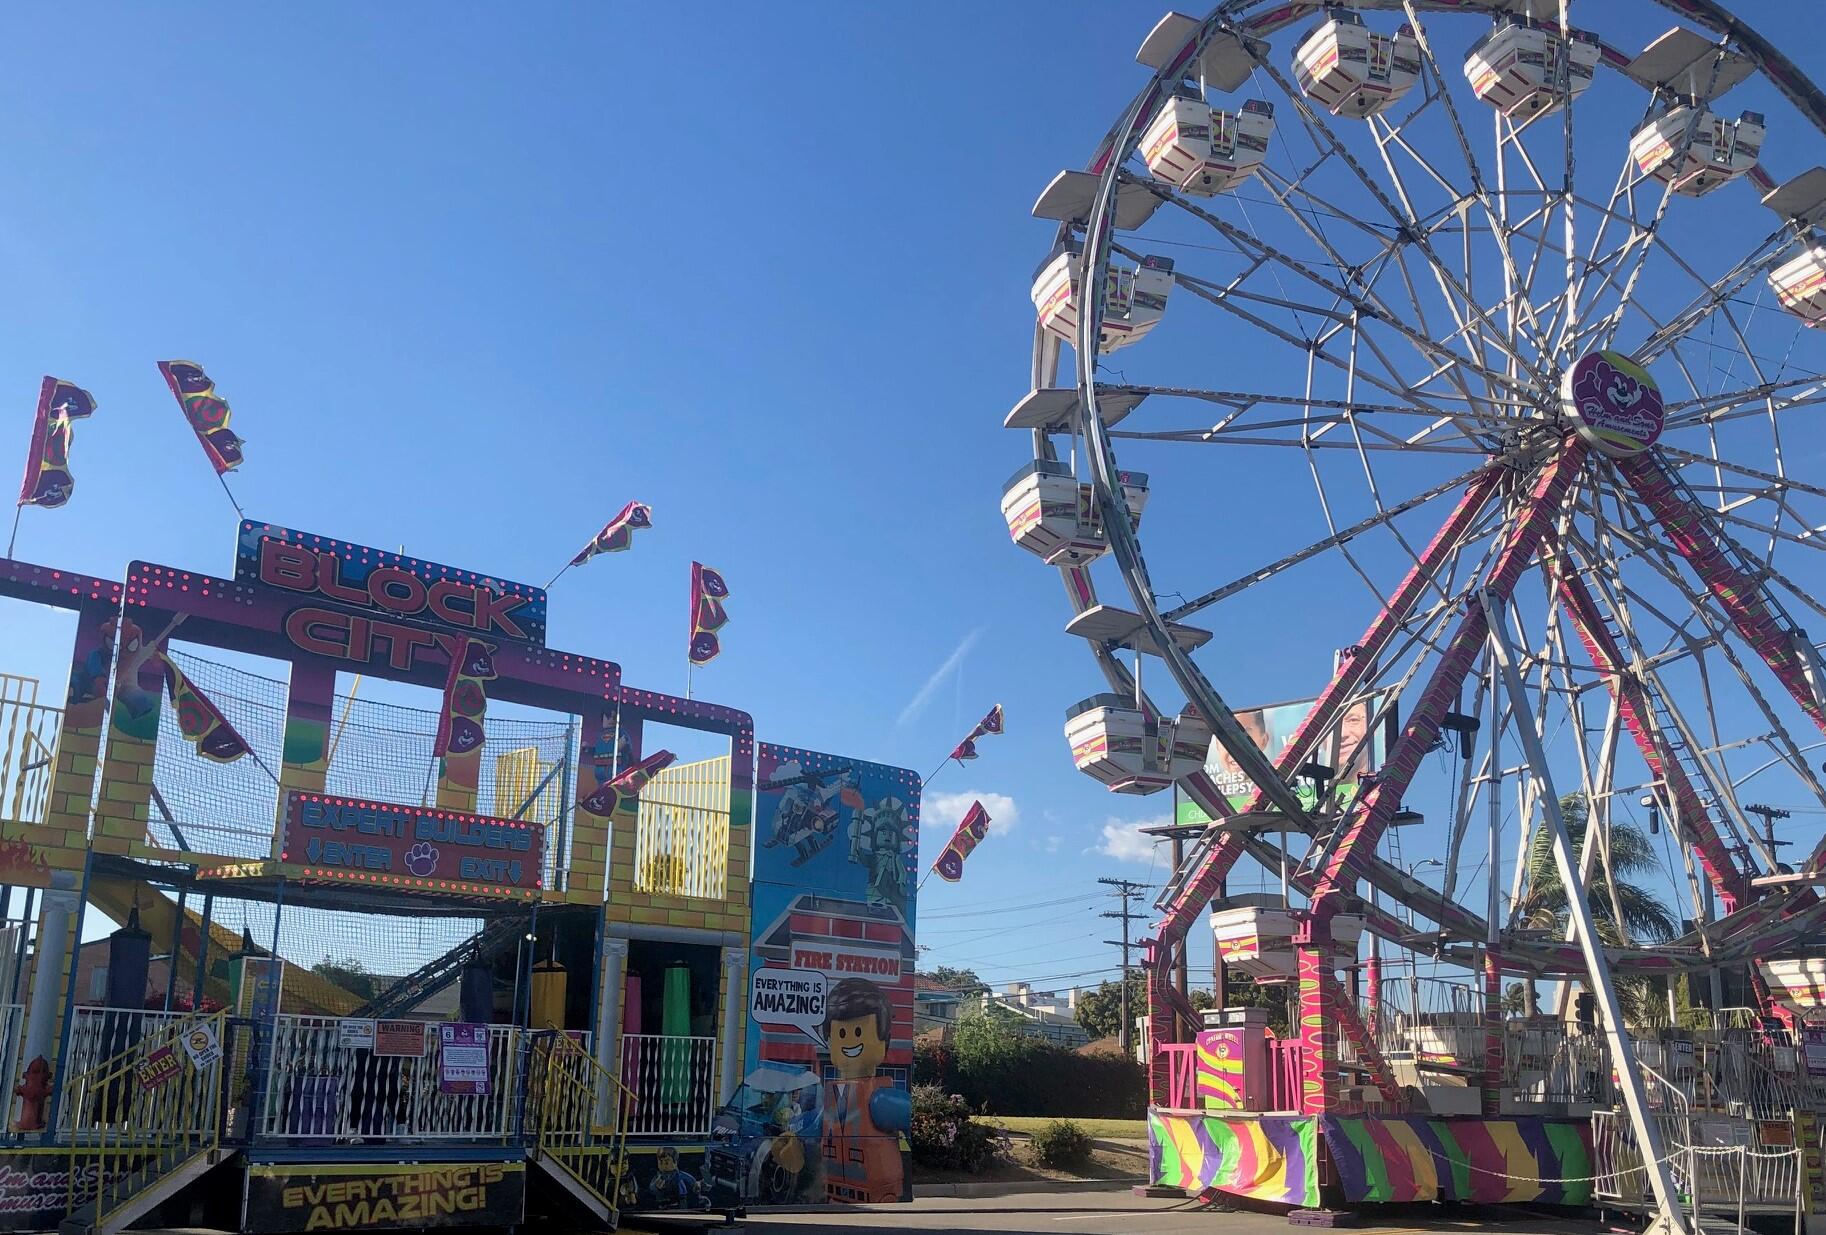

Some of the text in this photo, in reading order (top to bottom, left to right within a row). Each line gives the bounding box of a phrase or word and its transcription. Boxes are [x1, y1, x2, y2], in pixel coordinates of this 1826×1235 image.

[260, 539, 528, 639] BLOCK
[303, 801, 533, 851] EXPERT BUILDERS
[323, 840, 508, 882] ENTER EXIT
[794, 950, 900, 977] FIRE STATION
[755, 977, 822, 993] EVERYTHING IS
[754, 991, 825, 1015] AMAZING!
[382, 1023, 421, 1034] WARNING
[139, 1054, 177, 1083] ENTER
[282, 1164, 504, 1209] EVERYTHING IS
[304, 1187, 487, 1232] AMAZING!
